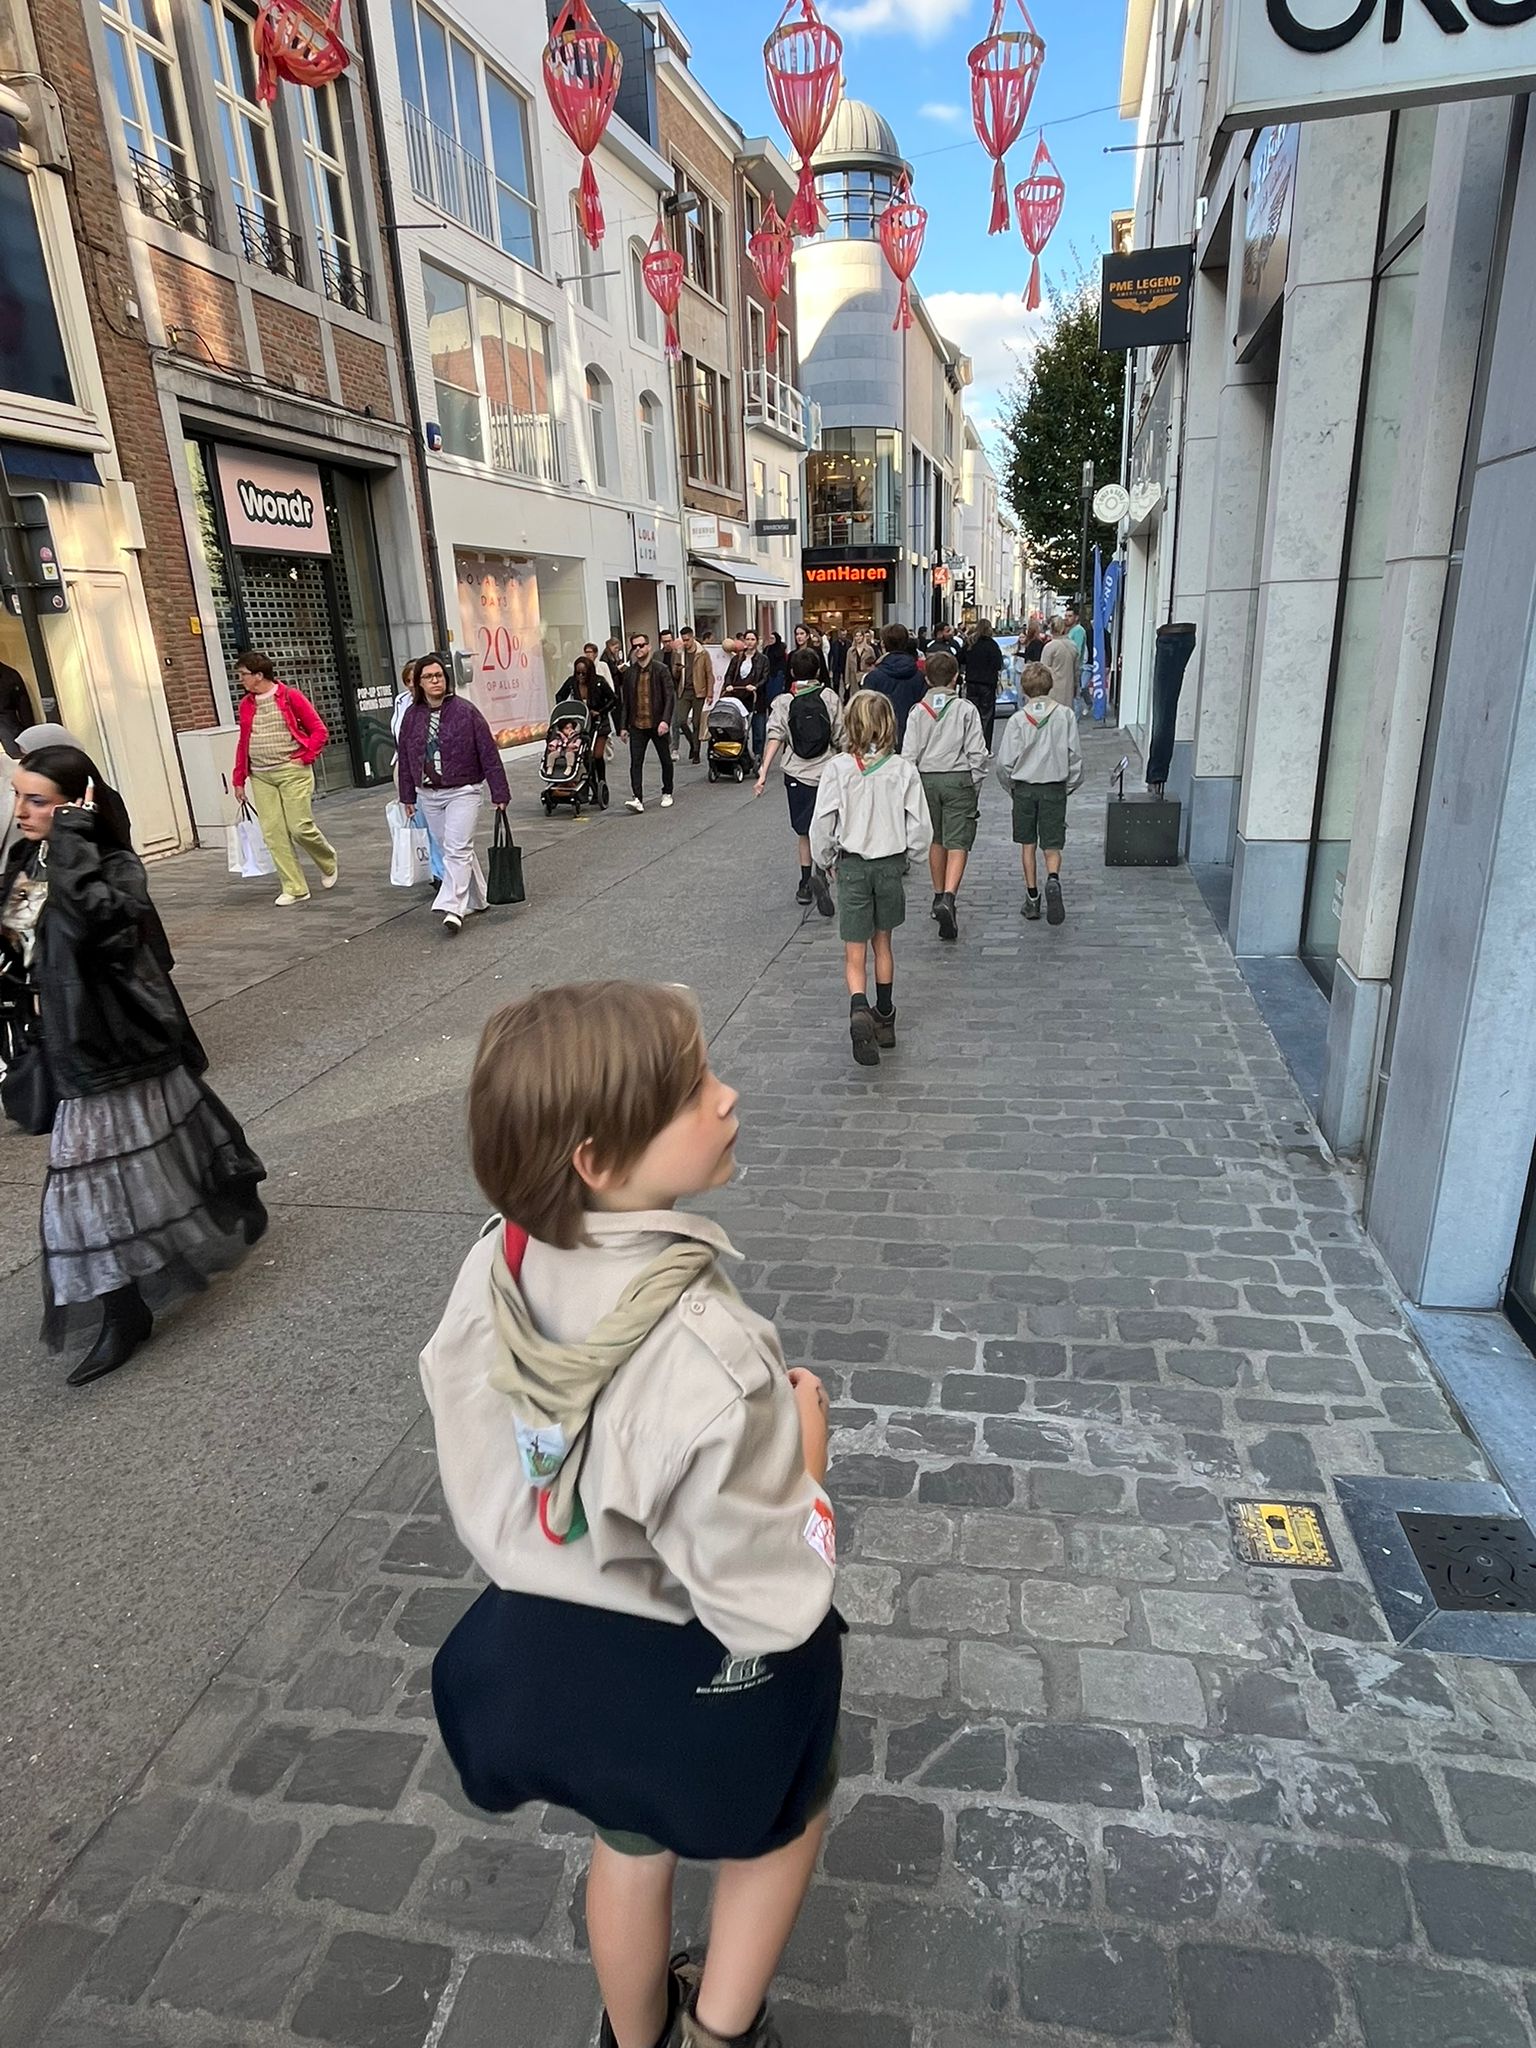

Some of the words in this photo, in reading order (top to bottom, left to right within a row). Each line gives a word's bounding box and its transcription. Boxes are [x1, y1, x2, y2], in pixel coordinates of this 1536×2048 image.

[1109, 281, 1133, 292] PME
[1136, 275, 1182, 289] LEGEND
[239, 482, 312, 525] Wondr
[638, 527, 656, 542] LOLA
[640, 547, 657, 560] LIZA
[806, 565, 887, 582] vanHaren
[964, 567, 976, 606] ONLY
[481, 595, 508, 608] DAYS
[478, 626, 528, 671] 20%
[486, 681, 497, 692] OP
[499, 678, 520, 690] ALLES
